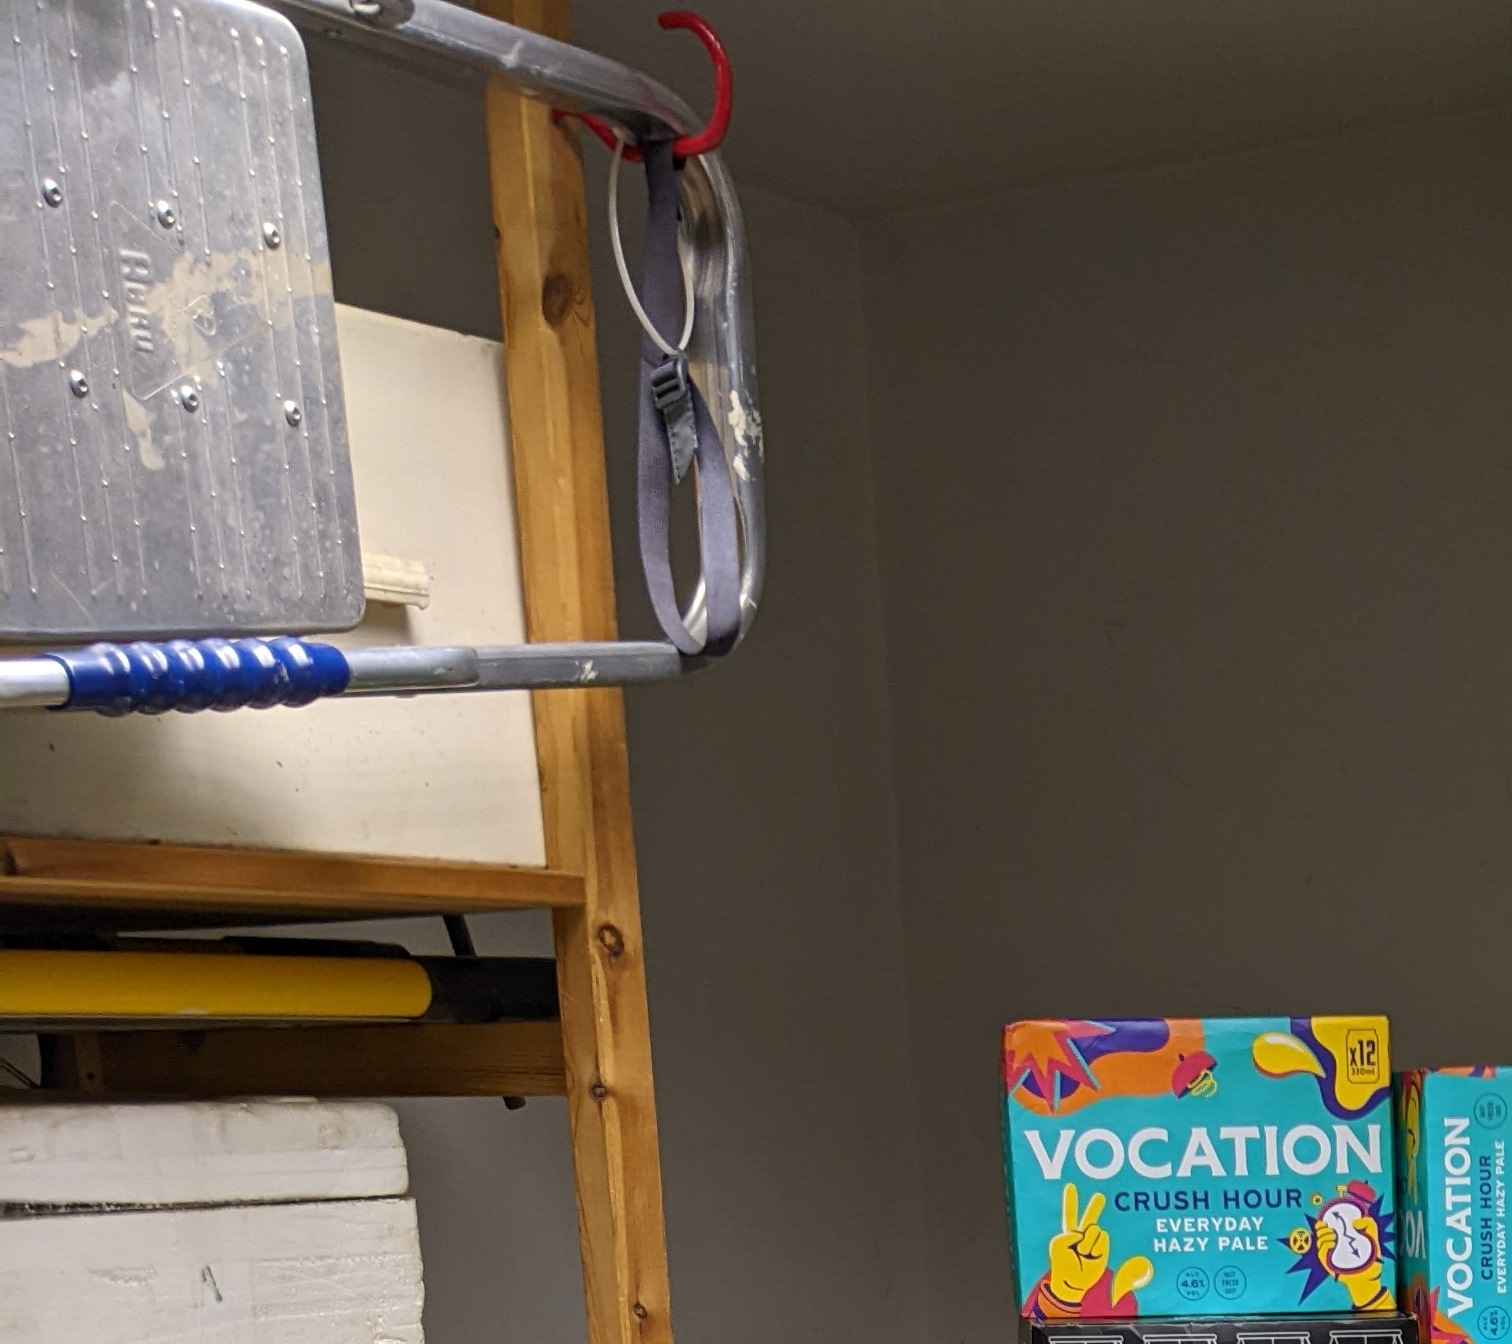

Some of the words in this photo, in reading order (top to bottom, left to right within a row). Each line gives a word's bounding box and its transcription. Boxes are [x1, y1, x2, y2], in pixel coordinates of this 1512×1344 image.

[1350, 1039, 1377, 1068] x12
[1024, 1124, 1383, 1181] VOCATION
[1494, 1140, 1505, 1181] PALE
[1115, 1190, 1210, 1212] CRUSH
[1224, 1187, 1303, 1210] HOUR
[1479, 1154, 1492, 1210] HOUR
[1495, 1181, 1506, 1217] HAZY
[1156, 1217, 1265, 1233] EVERYDAY
[1444, 1116, 1473, 1318] VOCATION
[1154, 1237, 1210, 1253] HAZY
[1218, 1236, 1269, 1252] PALE
[1480, 1217, 1493, 1281] CRUSH
[1497, 1221, 1508, 1294] EVERYDAY
